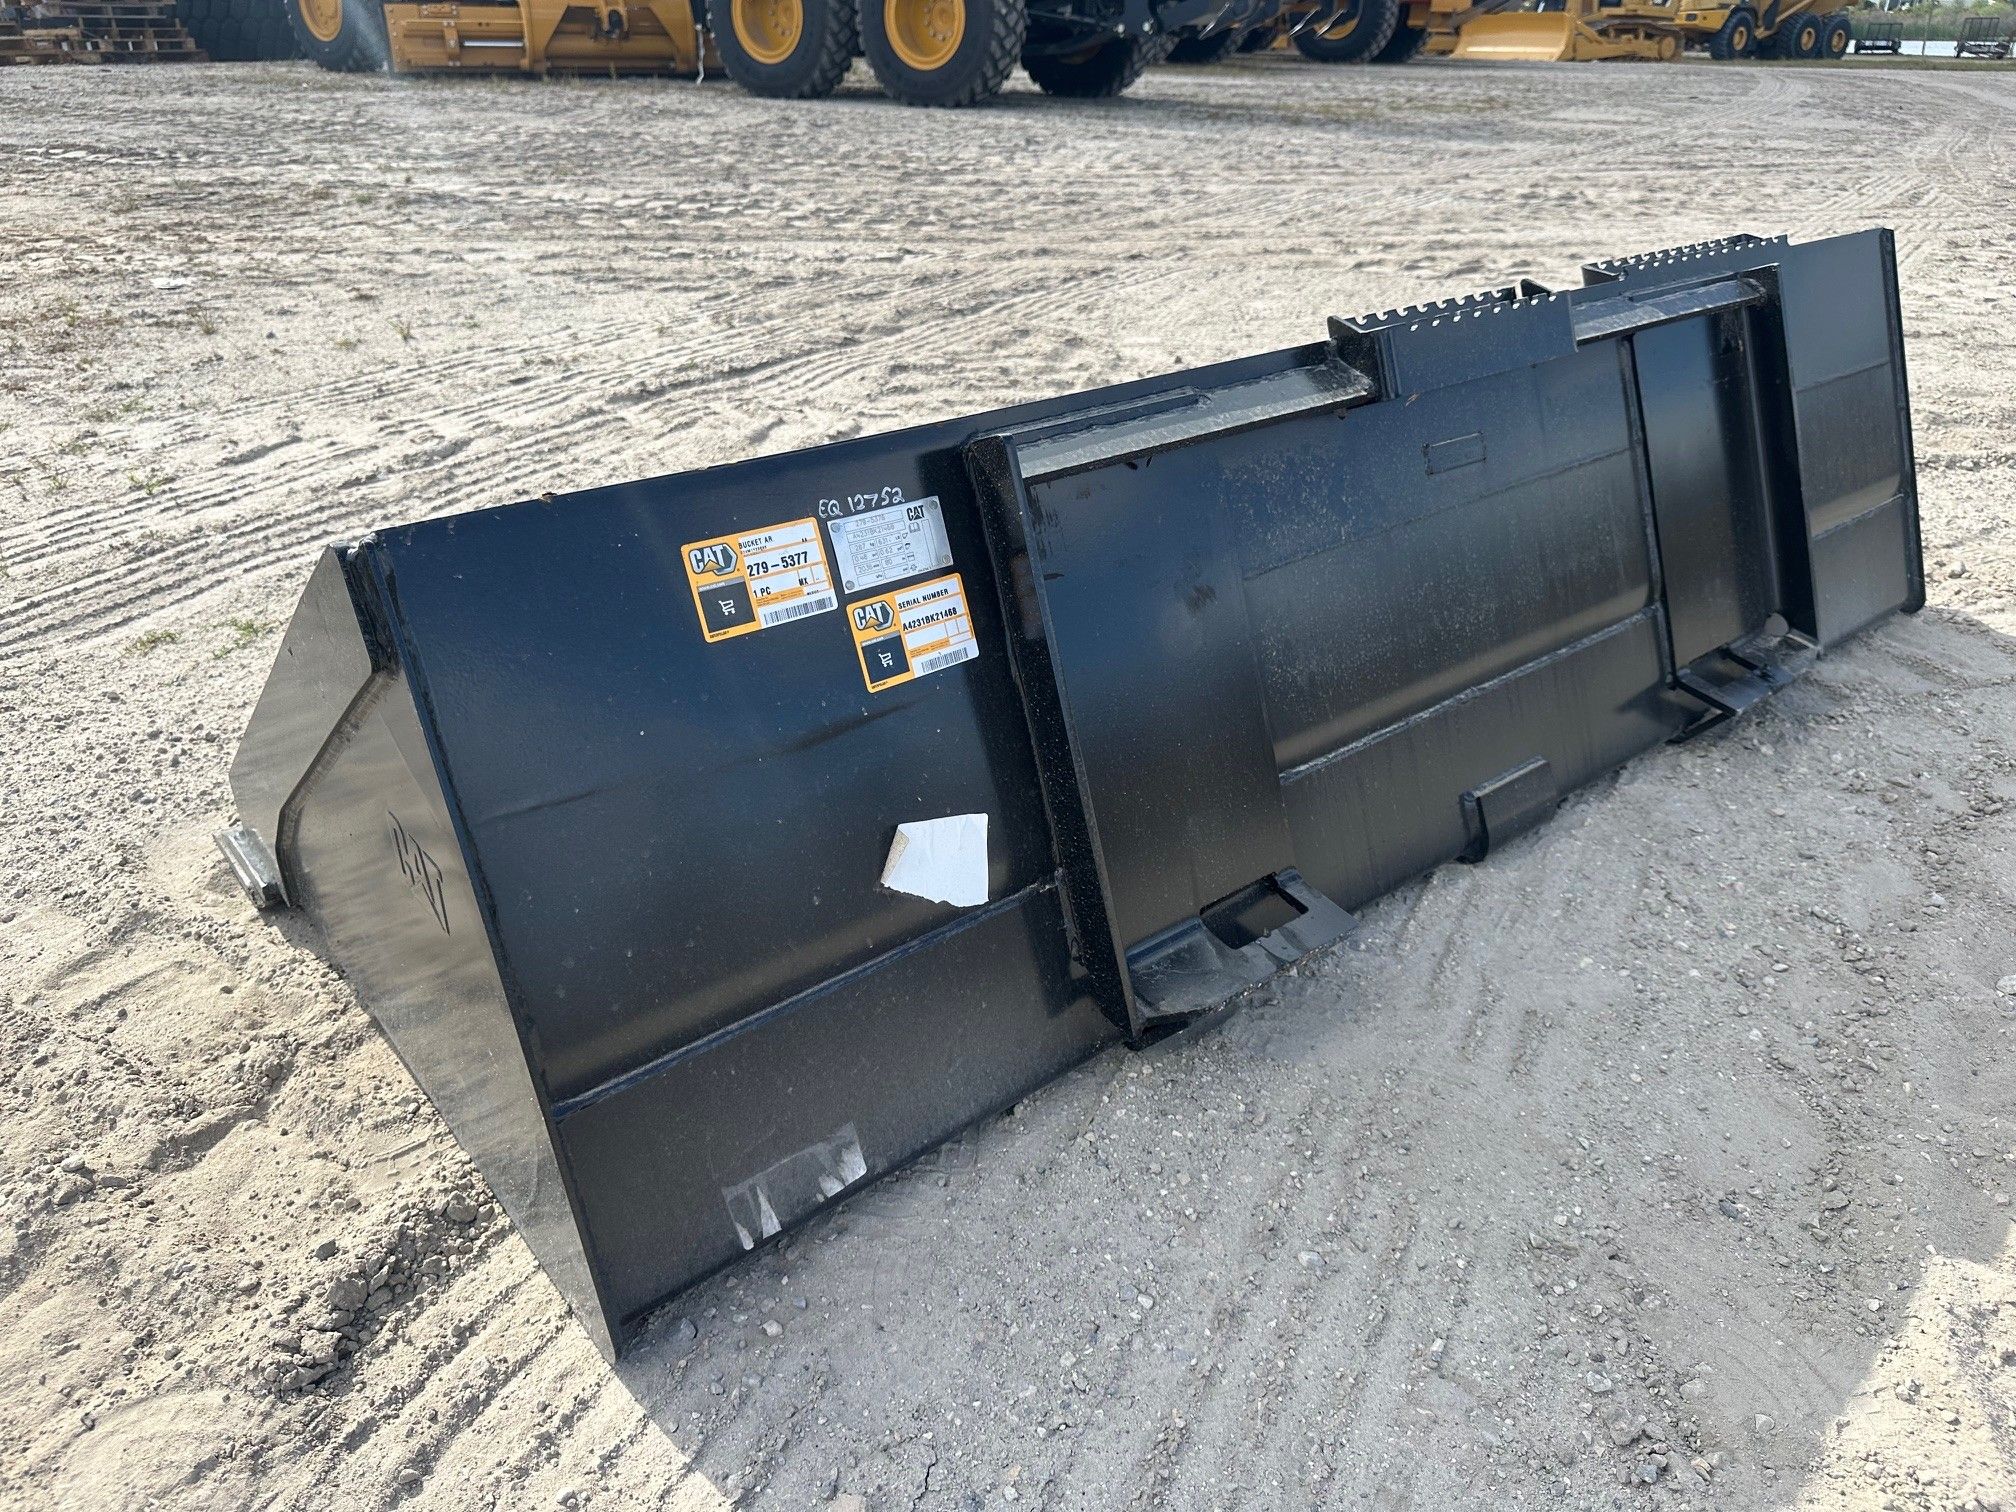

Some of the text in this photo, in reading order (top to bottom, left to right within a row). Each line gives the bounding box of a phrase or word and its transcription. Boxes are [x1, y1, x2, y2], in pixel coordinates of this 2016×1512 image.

[819, 499, 843, 518] EQ
[907, 505, 925, 521] CAT
[738, 538, 762, 549] BUCKET
[689, 544, 725, 574] CAT
[746, 551, 808, 577] 279-5377
[760, 586, 771, 597] PC
[898, 588, 949, 609] SERIAL NUMBER
[853, 602, 884, 630] CAT
